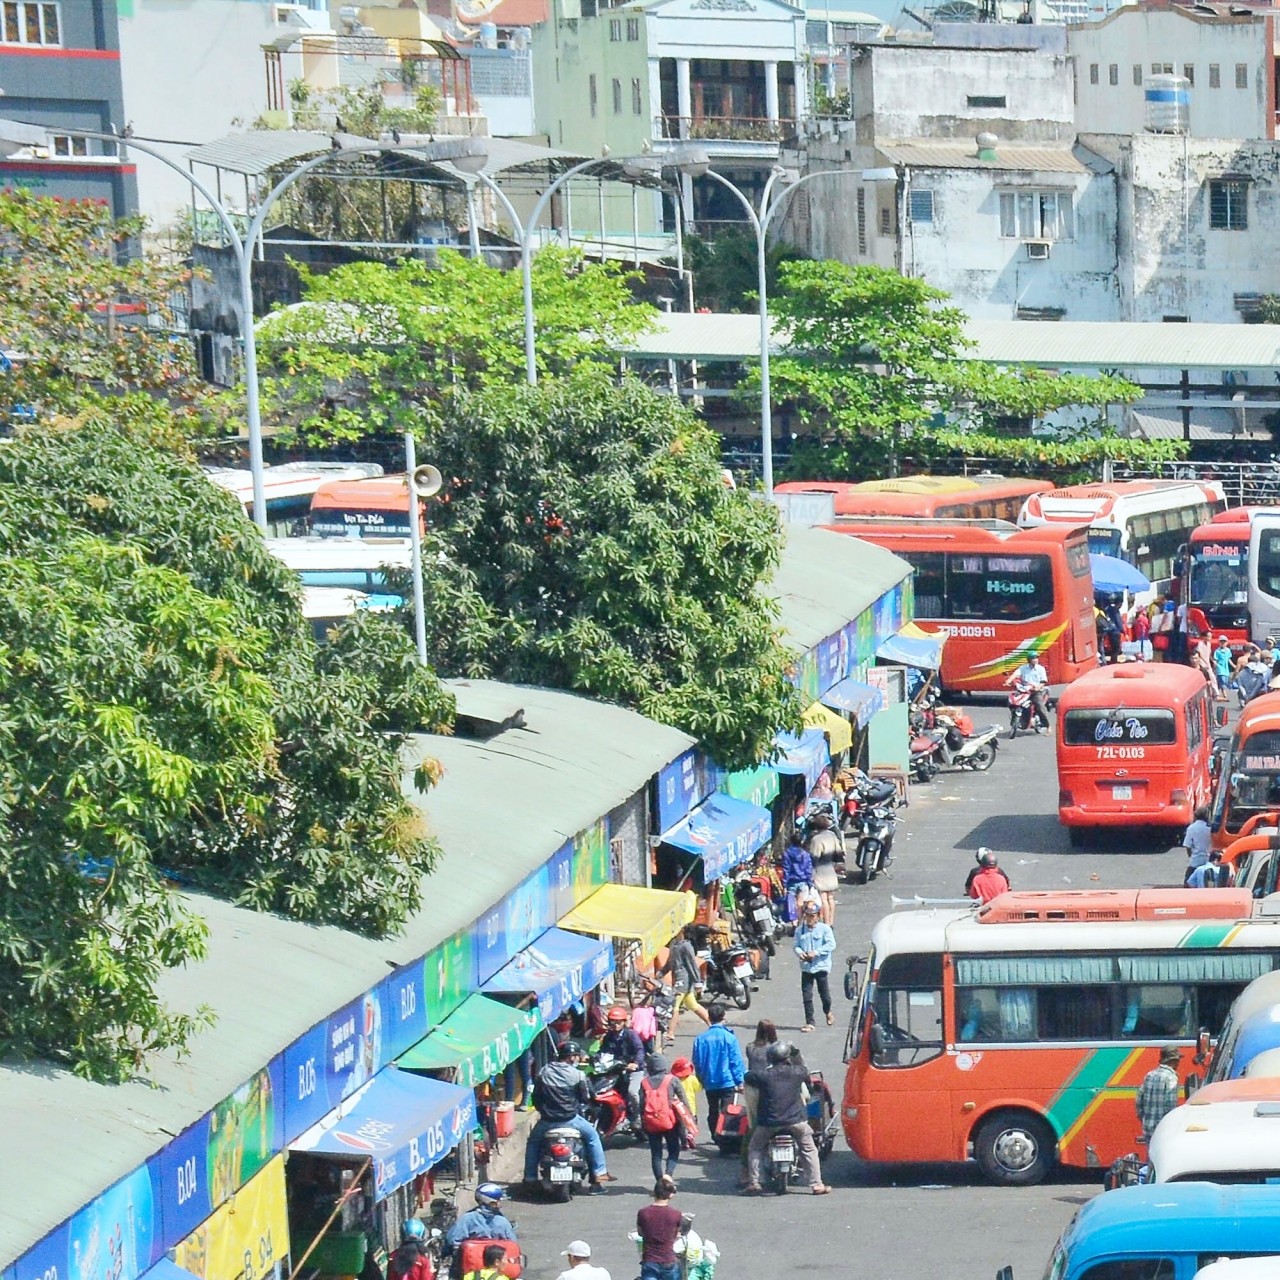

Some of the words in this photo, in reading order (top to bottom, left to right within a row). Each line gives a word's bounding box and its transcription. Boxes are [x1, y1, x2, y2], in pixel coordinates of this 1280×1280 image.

[986, 579, 1035, 594] Home
[1096, 746, 1146, 760] 72L-0103
[409, 1136, 426, 1172] B.
[426, 1126, 445, 1160] 05
[177, 1156, 197, 1205] B.04
